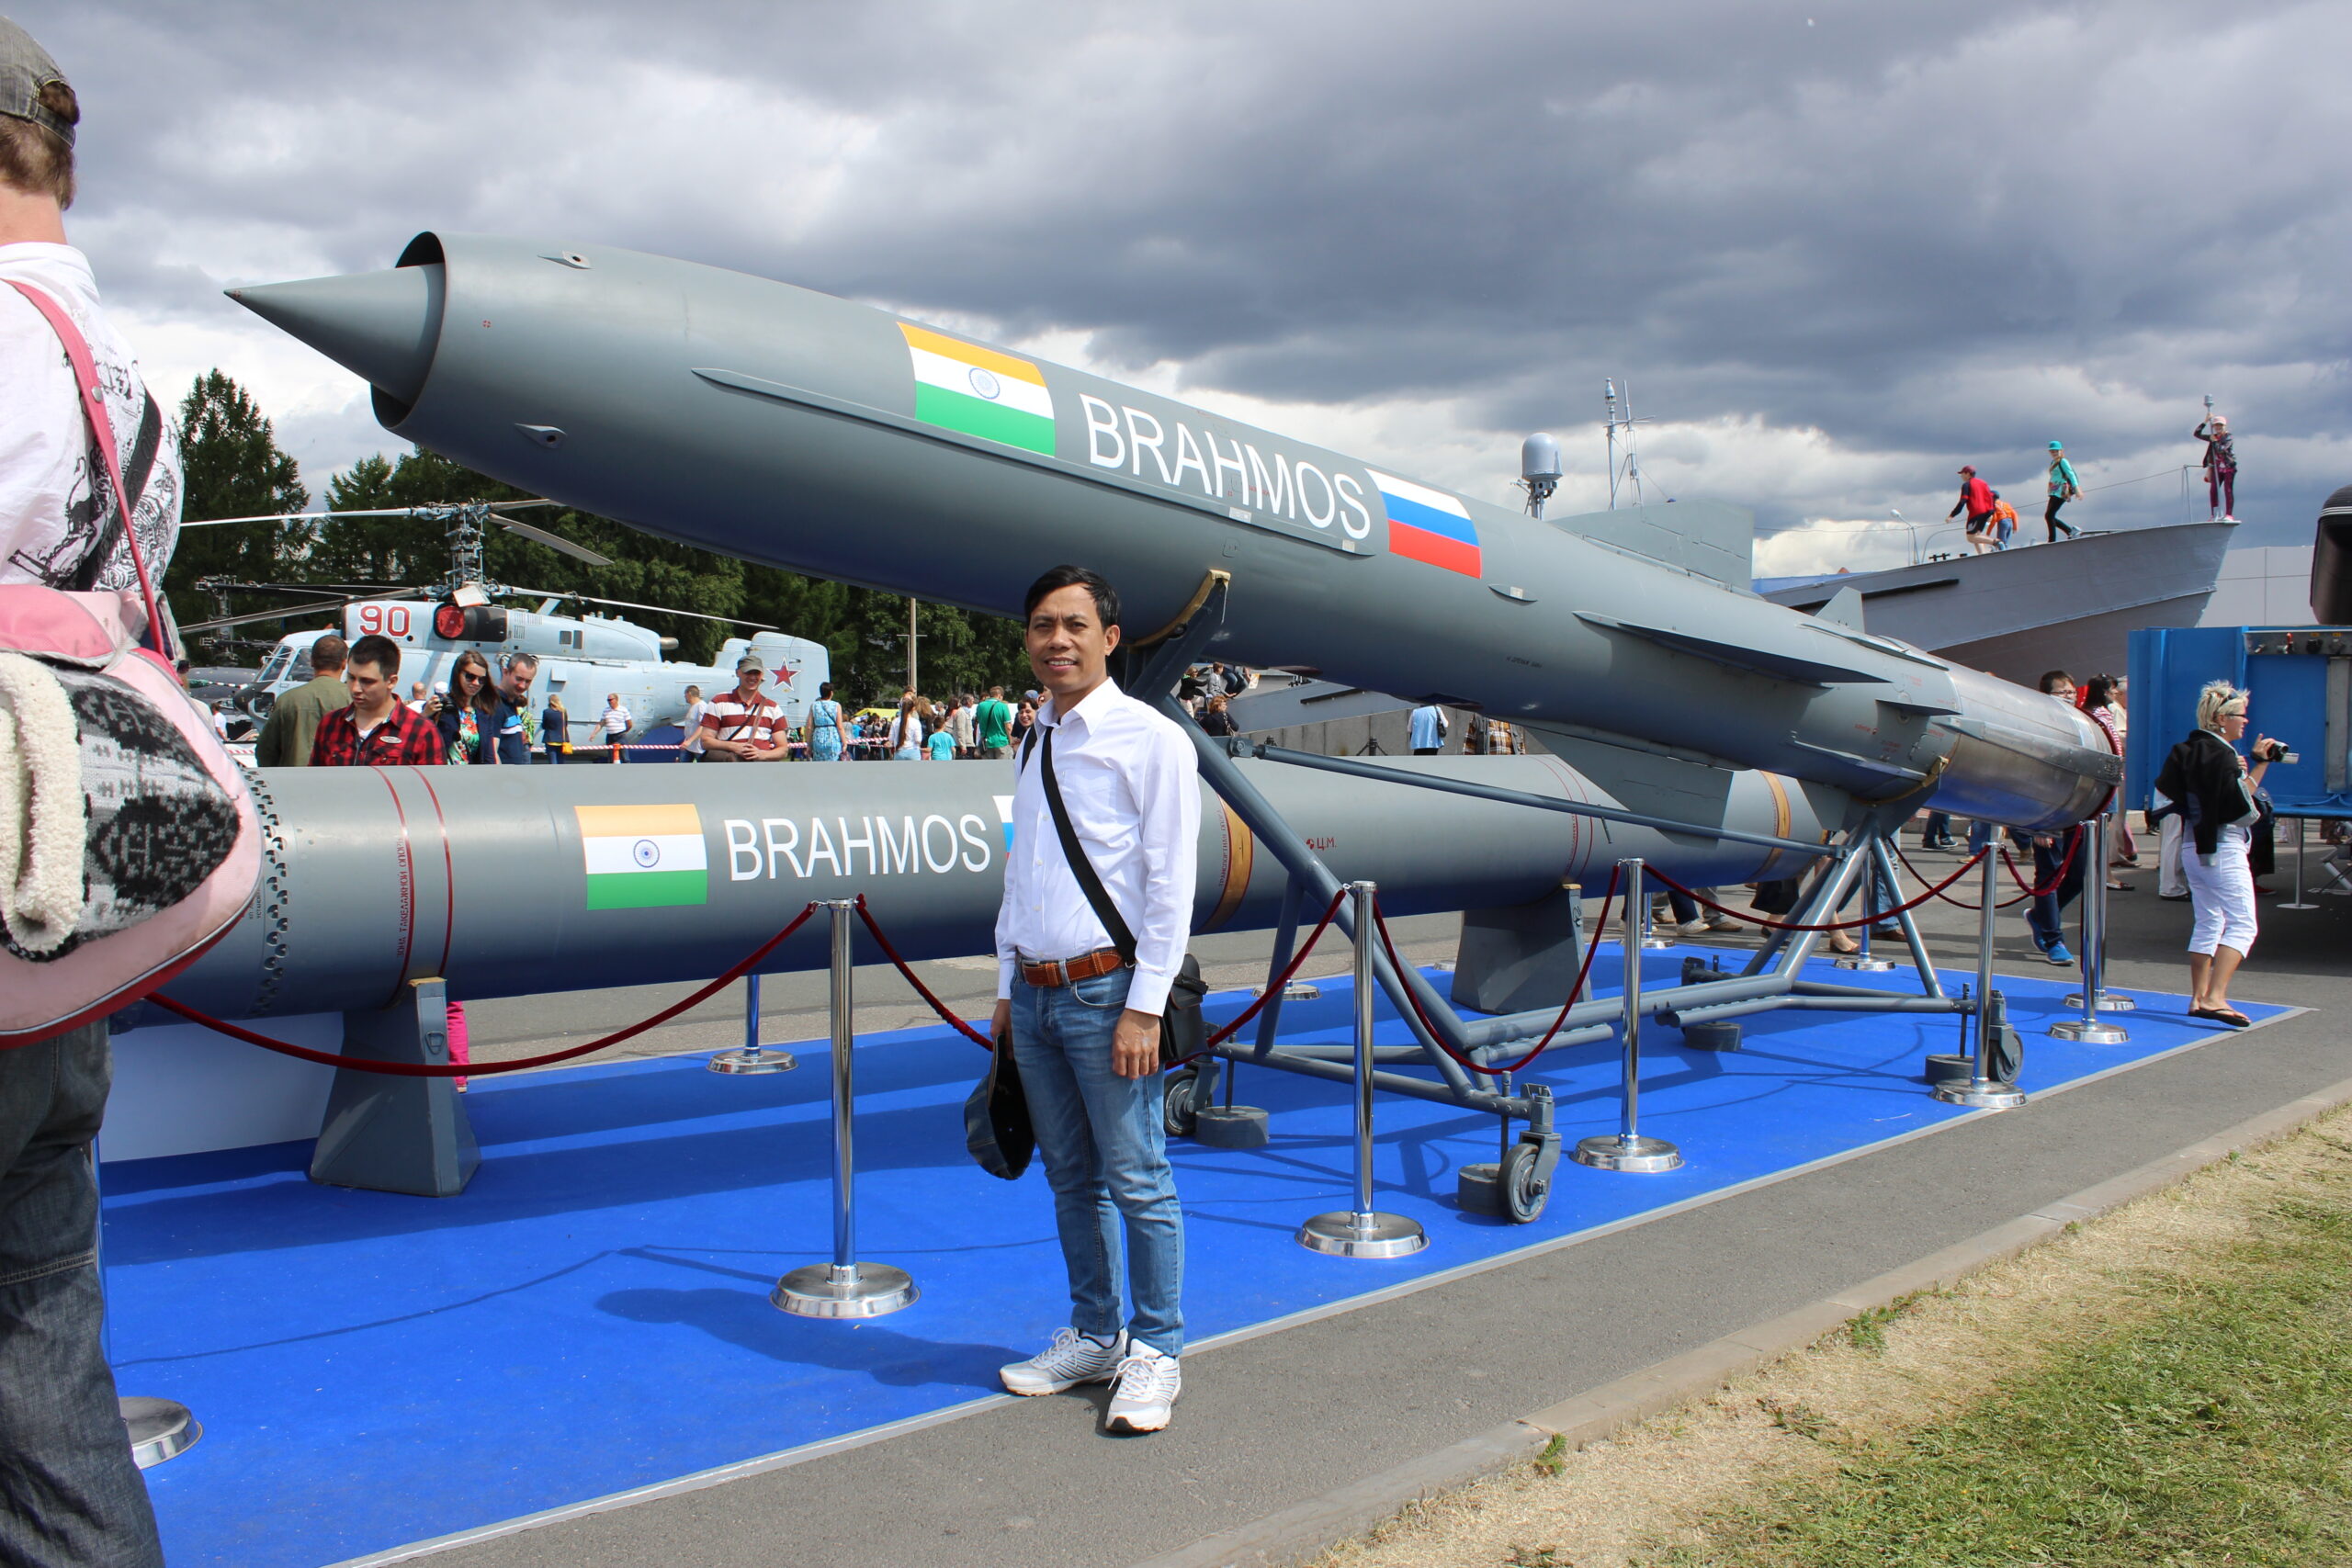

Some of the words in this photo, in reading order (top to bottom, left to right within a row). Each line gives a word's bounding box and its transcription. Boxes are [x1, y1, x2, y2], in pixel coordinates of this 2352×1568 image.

[1079, 392, 1371, 540] BRAHMOS
[359, 604, 411, 637] 90
[724, 814, 991, 882] BRAHMOS
